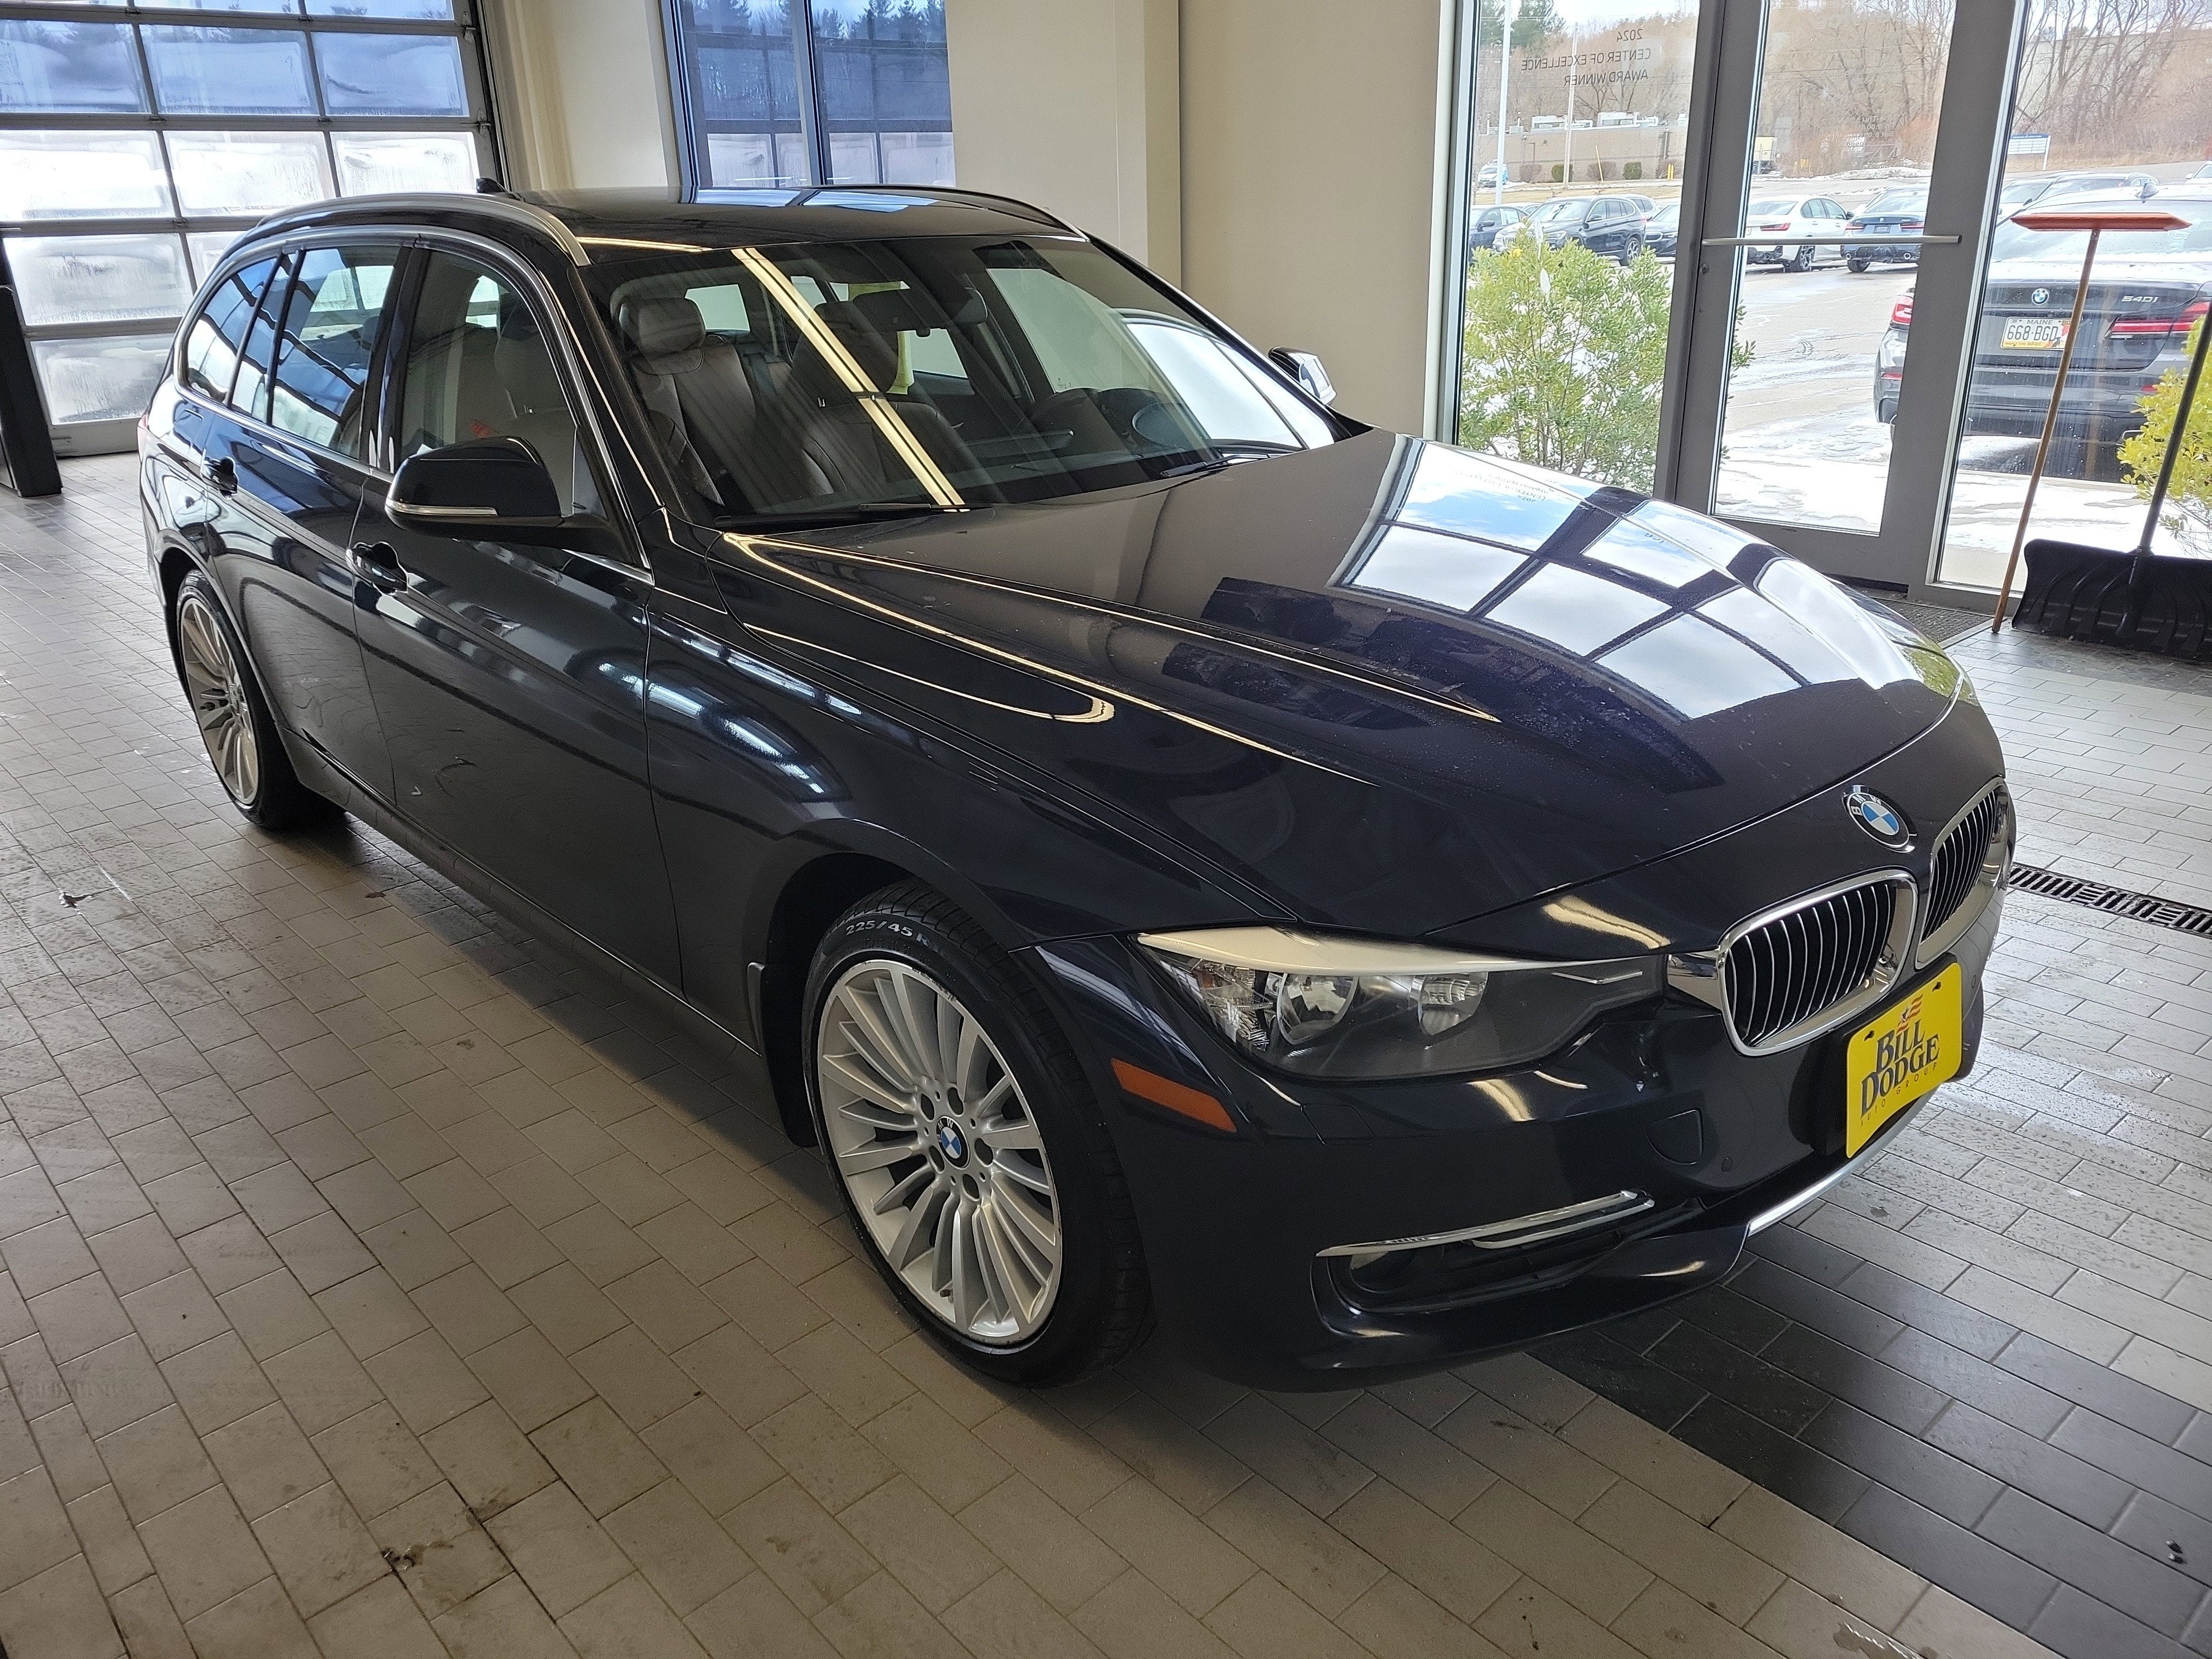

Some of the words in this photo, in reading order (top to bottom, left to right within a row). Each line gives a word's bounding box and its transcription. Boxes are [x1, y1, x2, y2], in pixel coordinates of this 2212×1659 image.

[1850, 794, 1882, 816] BMW
[845, 920, 913, 936] 225/45
[1876, 1019, 1926, 1074] BILL
[1860, 1033, 1940, 1120] DODGE
[1860, 1098, 1886, 1128] AUTO
[1896, 1062, 1937, 1095] GROUP
